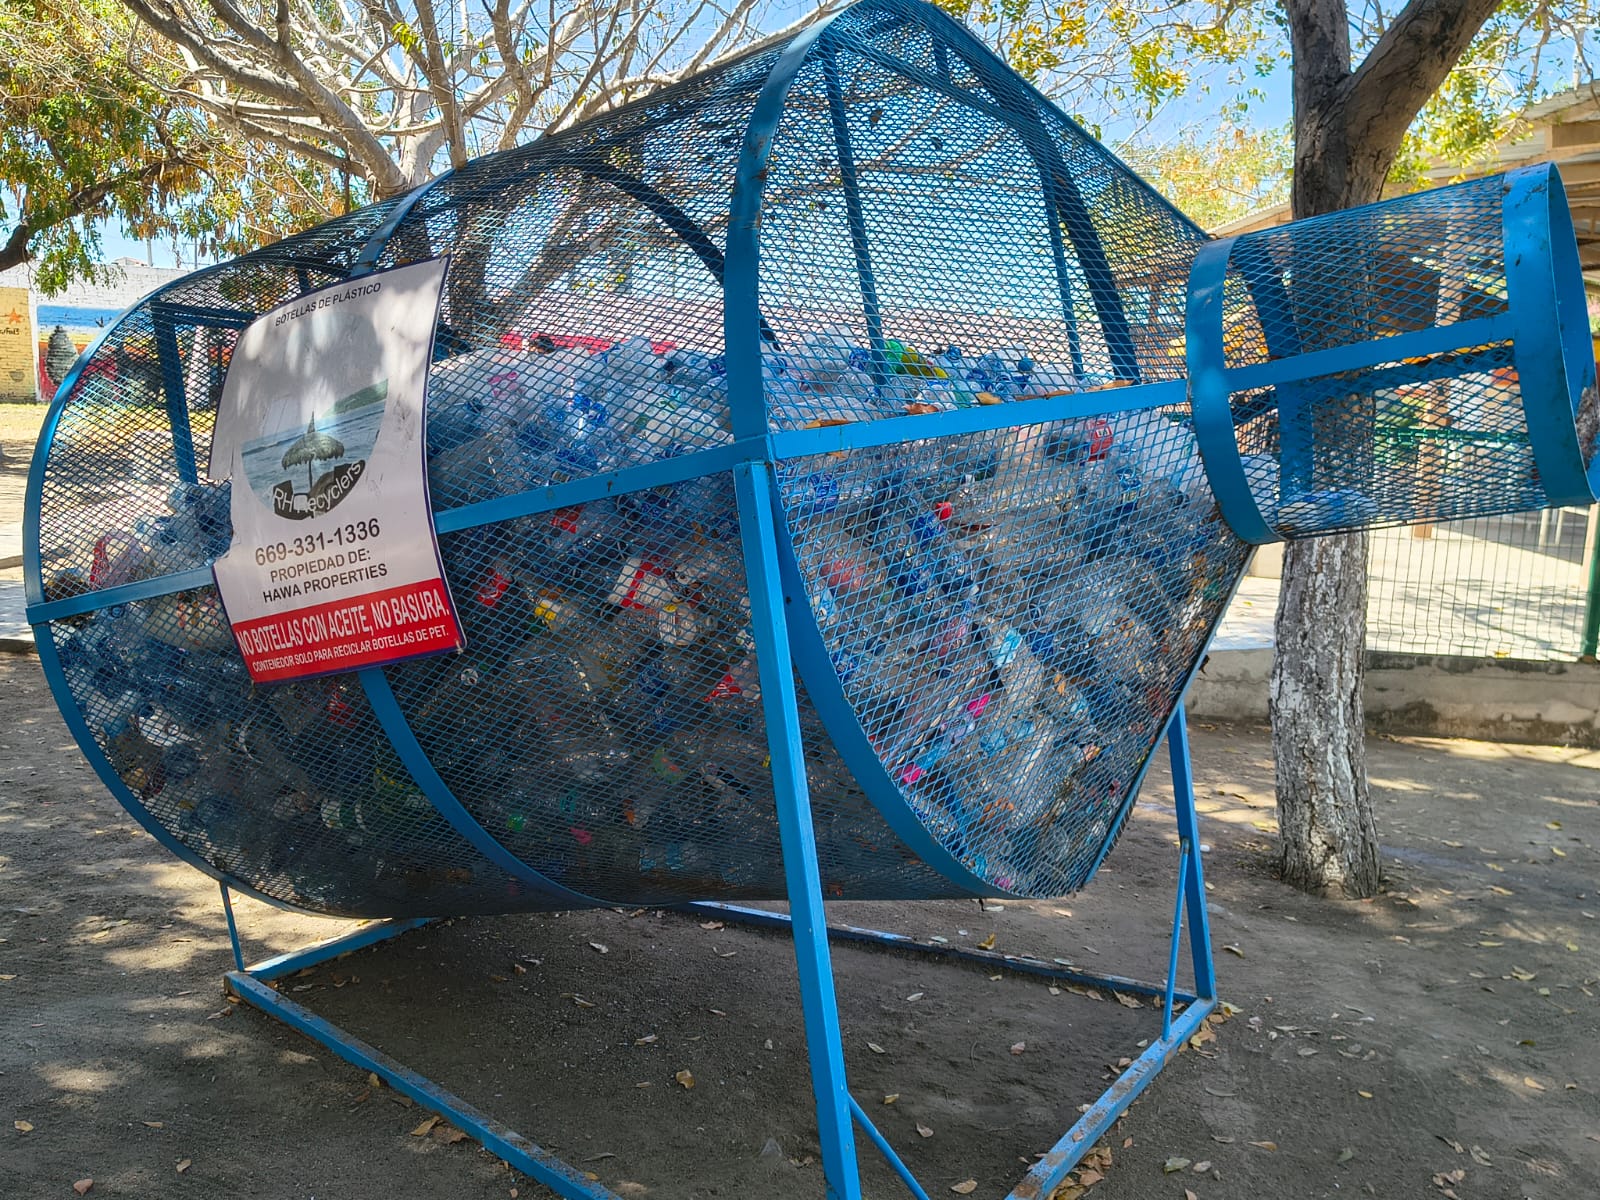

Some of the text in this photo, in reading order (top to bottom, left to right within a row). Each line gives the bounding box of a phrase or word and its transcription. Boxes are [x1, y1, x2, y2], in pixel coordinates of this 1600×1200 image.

[275, 282, 382, 326] BOTELLAS DE PLÁSTICO
[296, 462, 361, 514] ecyclers
[255, 518, 381, 566] 669-331-1336
[270, 548, 372, 583] PROPIEDAD DE:
[262, 563, 388, 603] HAWA PROPERTIES
[236, 588, 450, 657] NO BOTELLAS CON ACEITE, NO BASURA.
[252, 624, 449, 672] CONTENEDOR SOLO PARA RECICLAR BOTELLAS DE PET.
